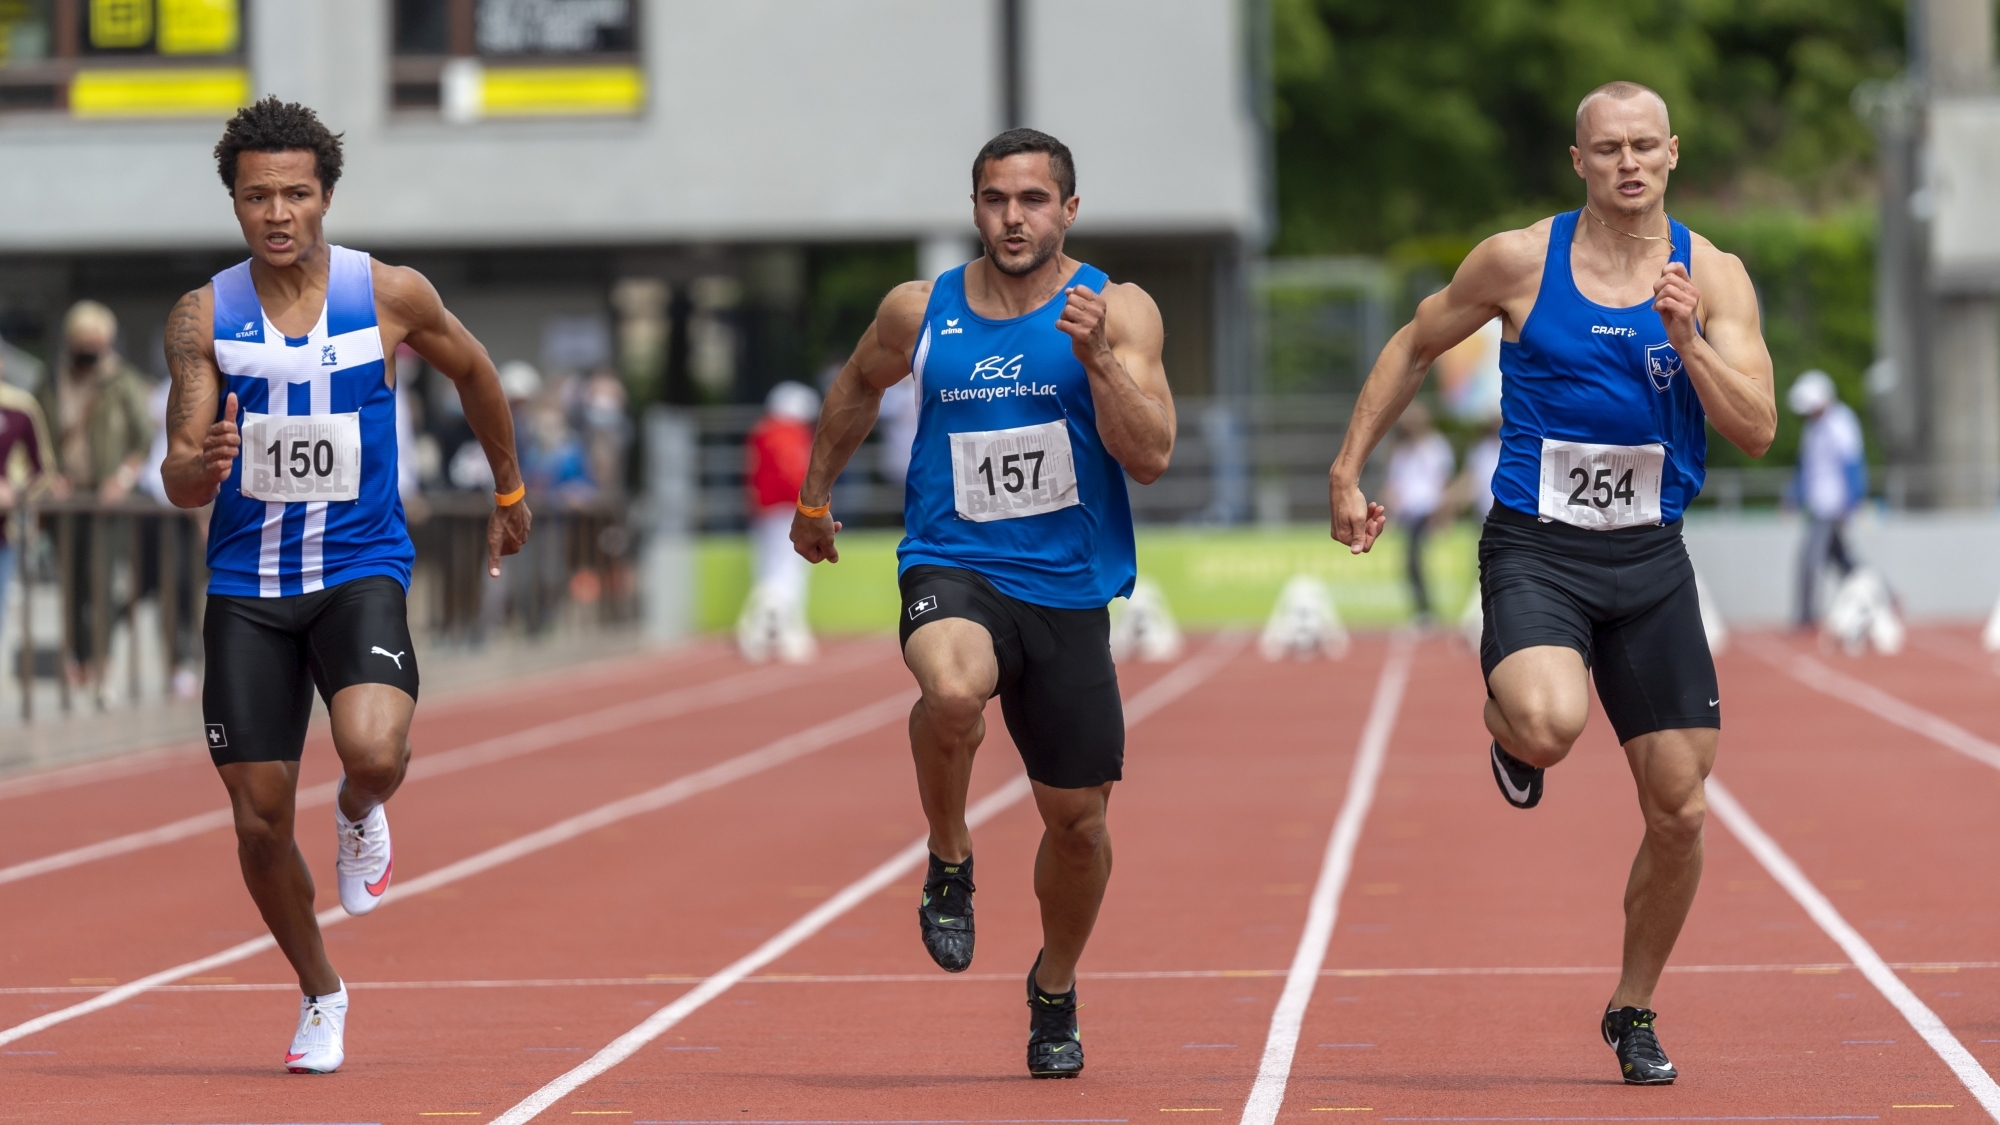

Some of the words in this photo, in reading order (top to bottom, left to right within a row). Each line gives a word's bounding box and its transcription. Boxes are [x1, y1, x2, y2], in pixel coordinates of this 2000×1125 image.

[235, 330, 259, 338] START
[940, 327, 963, 336] erima
[1591, 325, 1628, 336] CRAFT
[970, 353, 1024, 381] FSG
[940, 381, 1057, 403] Estavayer-le-Lac
[267, 439, 334, 478] 150
[253, 468, 349, 494] BASEL
[978, 450, 1045, 496] 157
[965, 477, 1065, 515] BASEL
[1566, 467, 1635, 509] 254
[1552, 495, 1650, 525] BASEL
